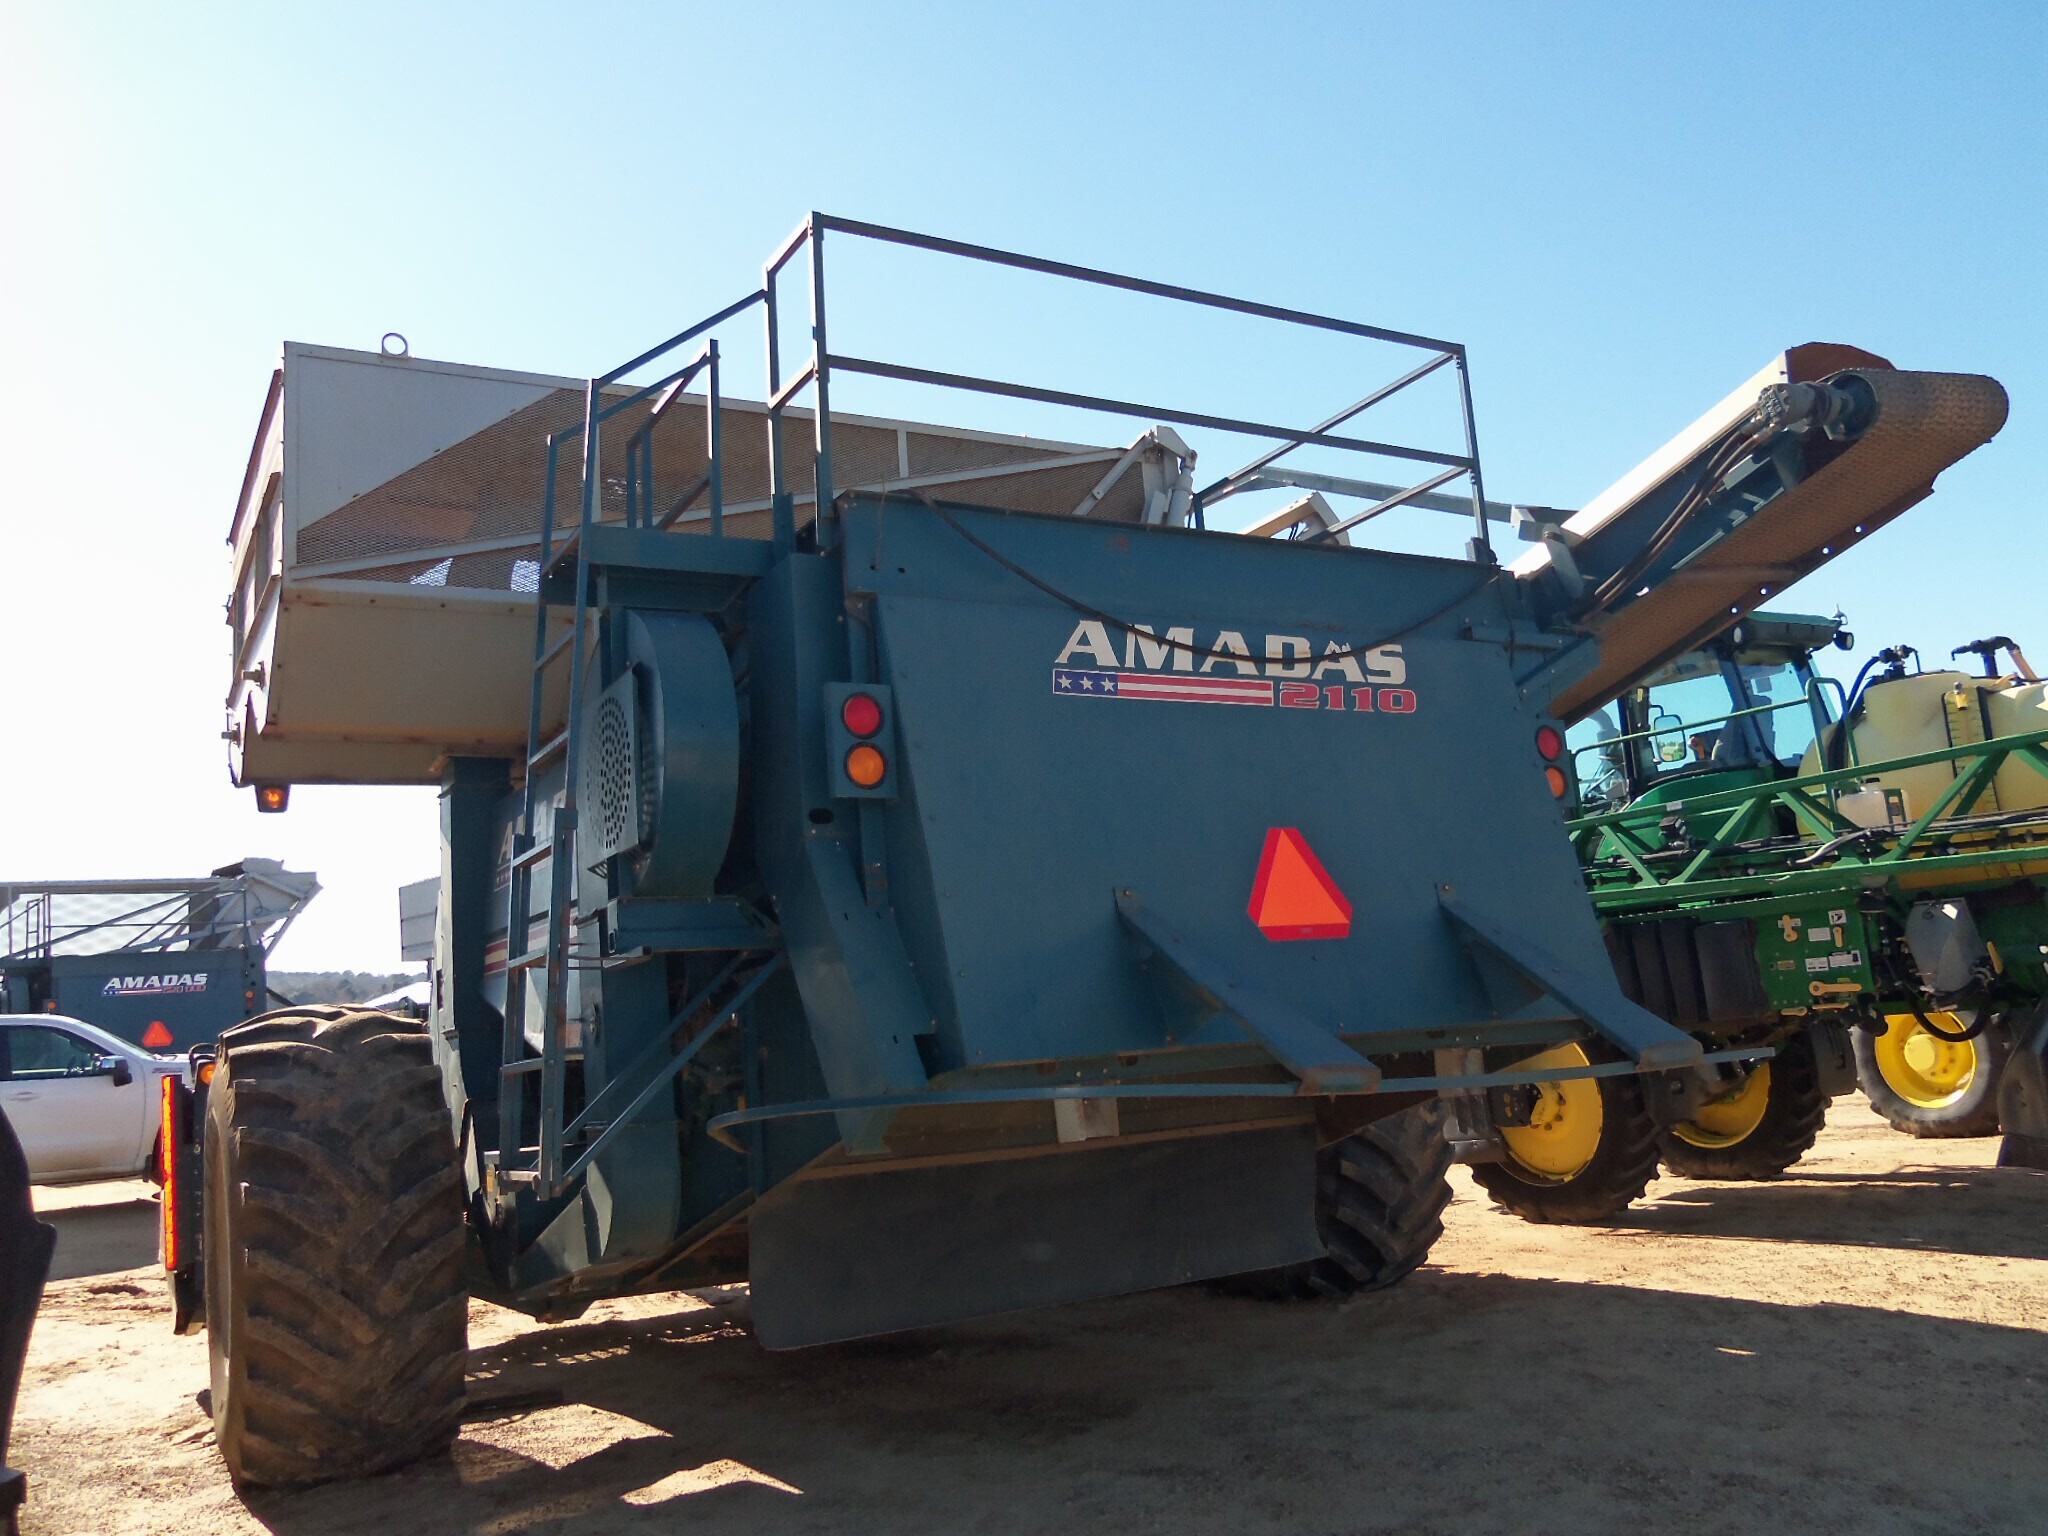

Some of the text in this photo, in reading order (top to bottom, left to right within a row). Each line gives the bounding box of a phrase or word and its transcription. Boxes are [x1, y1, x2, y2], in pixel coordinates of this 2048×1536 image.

[1054, 620, 1406, 685] AMADAS
[1279, 681, 1417, 714] 2110
[104, 973, 208, 990] AMADAS
